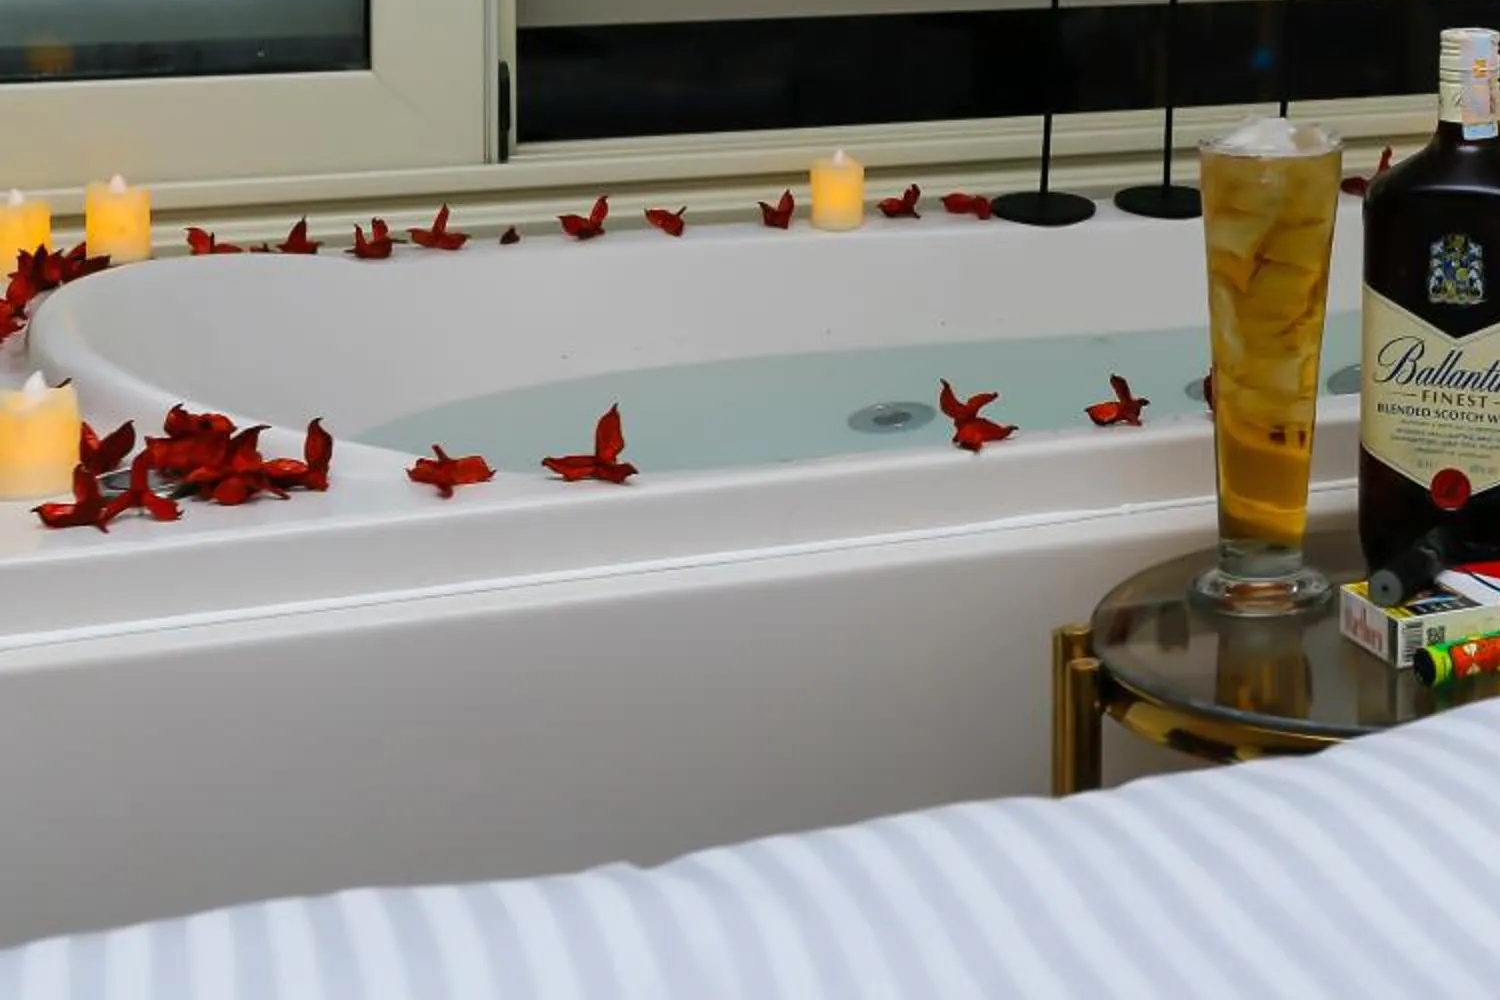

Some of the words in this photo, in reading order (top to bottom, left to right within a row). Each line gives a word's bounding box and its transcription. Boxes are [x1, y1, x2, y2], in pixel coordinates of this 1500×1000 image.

[1420, 390, 1488, 409] FINEST
[1377, 402, 1431, 418] BLENDED
[1434, 408, 1484, 423] SCOTCH
